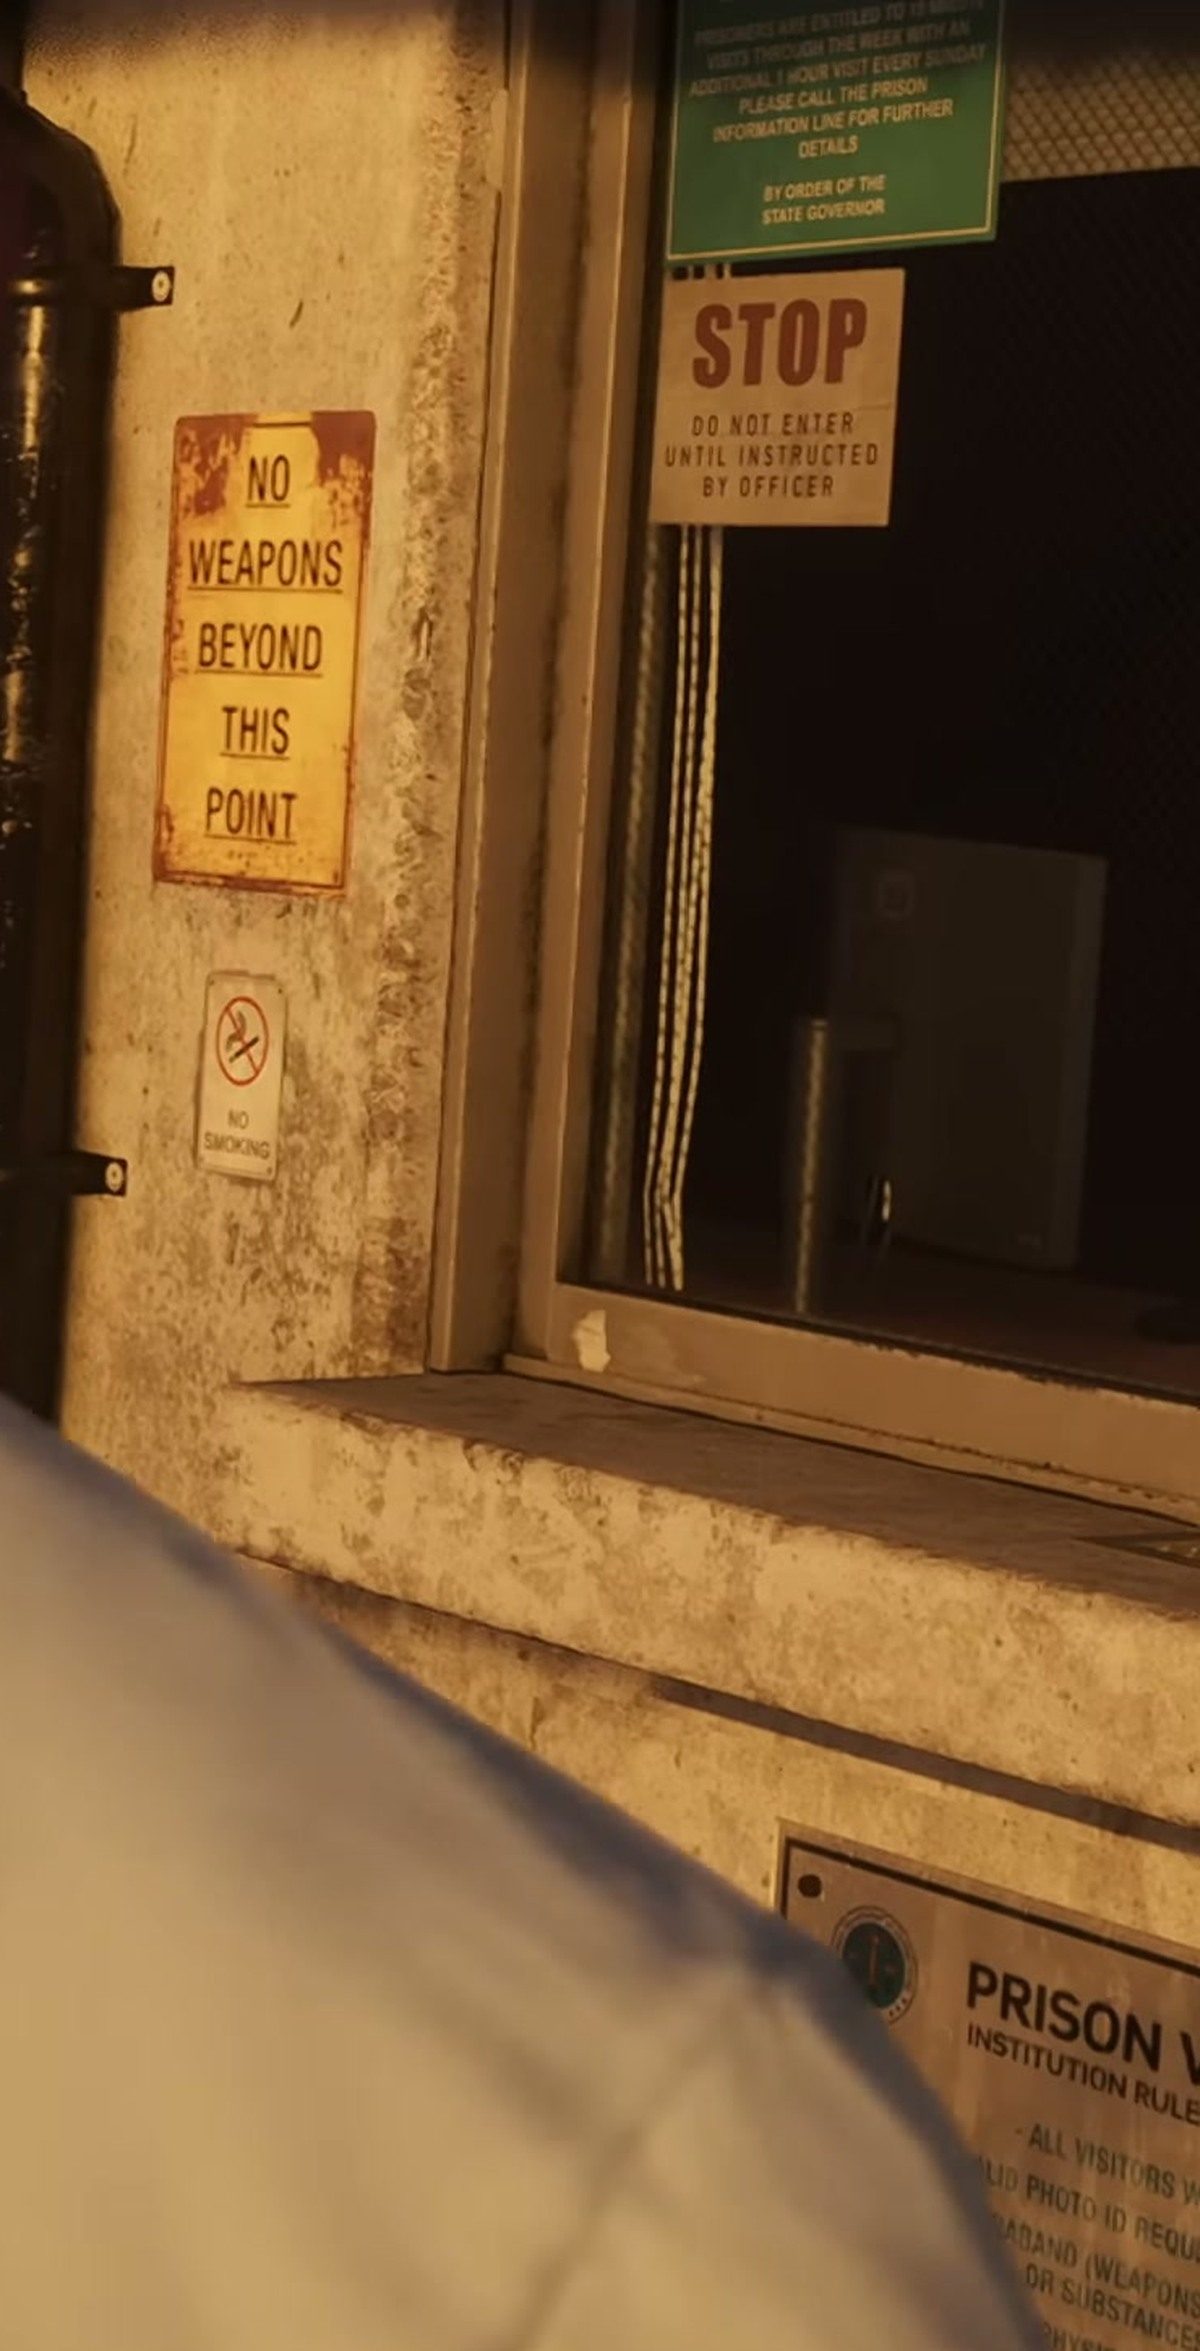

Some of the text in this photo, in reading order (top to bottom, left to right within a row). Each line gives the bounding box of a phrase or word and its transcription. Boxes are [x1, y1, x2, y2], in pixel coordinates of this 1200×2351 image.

[689, 72, 771, 98] ADDITIONAL
[786, 64, 829, 85] HOUR
[832, 57, 868, 78] VISIT
[873, 52, 922, 74] EVERY
[924, 43, 987, 67] SUNDAY
[739, 78, 928, 114] PLEASE CALL THE PRISON
[713, 98, 954, 143] INFORMATION LINE FOR FURTHER
[798, 136, 859, 158] DETAILS
[763, 174, 887, 202] BY ORDER OF THE
[762, 199, 885, 225] STATE GOVERNOR
[693, 298, 868, 388] STOP
[691, 412, 854, 437] DO NOT ENTER
[249, 454, 290, 501] NO
[665, 443, 879, 467] UNTIL INSTRUCTED
[703, 475, 834, 498] BY OFFICER
[189, 539, 343, 587] WEAPONS
[198, 622, 323, 671] BEYOND
[221, 706, 290, 755] THIS
[206, 786, 297, 839] POINT
[228, 1109, 249, 1130] NO
[204, 1131, 270, 1160] SMOKING
[966, 1961, 1162, 2072] PRISON
[967, 2022, 1128, 2099] INSTITUTION
[1028, 2122, 1066, 2159] ALL
[1075, 2136, 1175, 2199] VISITORS
[1027, 2173, 1097, 2222] PHOTO
[1104, 2204, 1127, 2234] ID
[1026, 2263, 1054, 2294] OR
